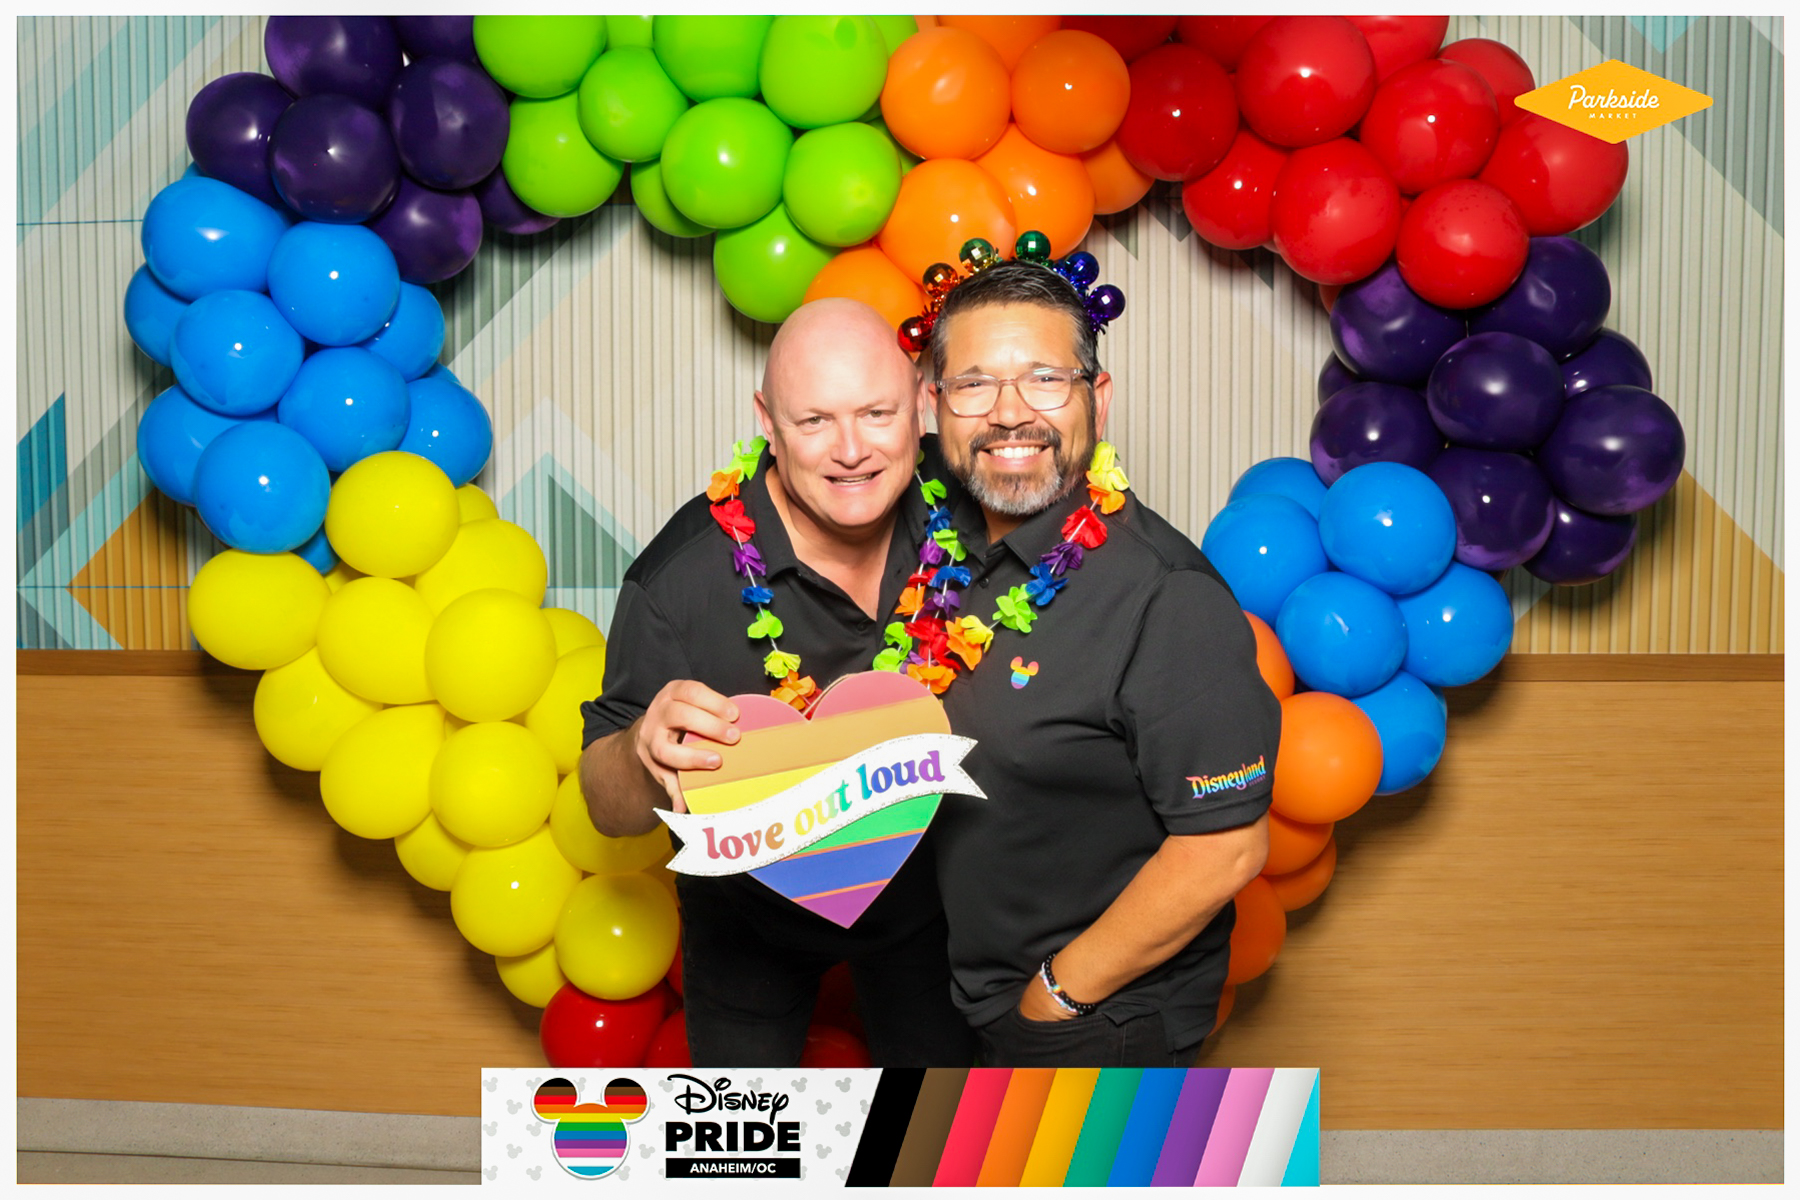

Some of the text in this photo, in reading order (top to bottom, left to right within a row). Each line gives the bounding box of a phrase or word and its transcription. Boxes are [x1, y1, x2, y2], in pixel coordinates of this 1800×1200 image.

[702, 750, 946, 860] love out loud
[1185, 754, 1267, 799] Disneyland
